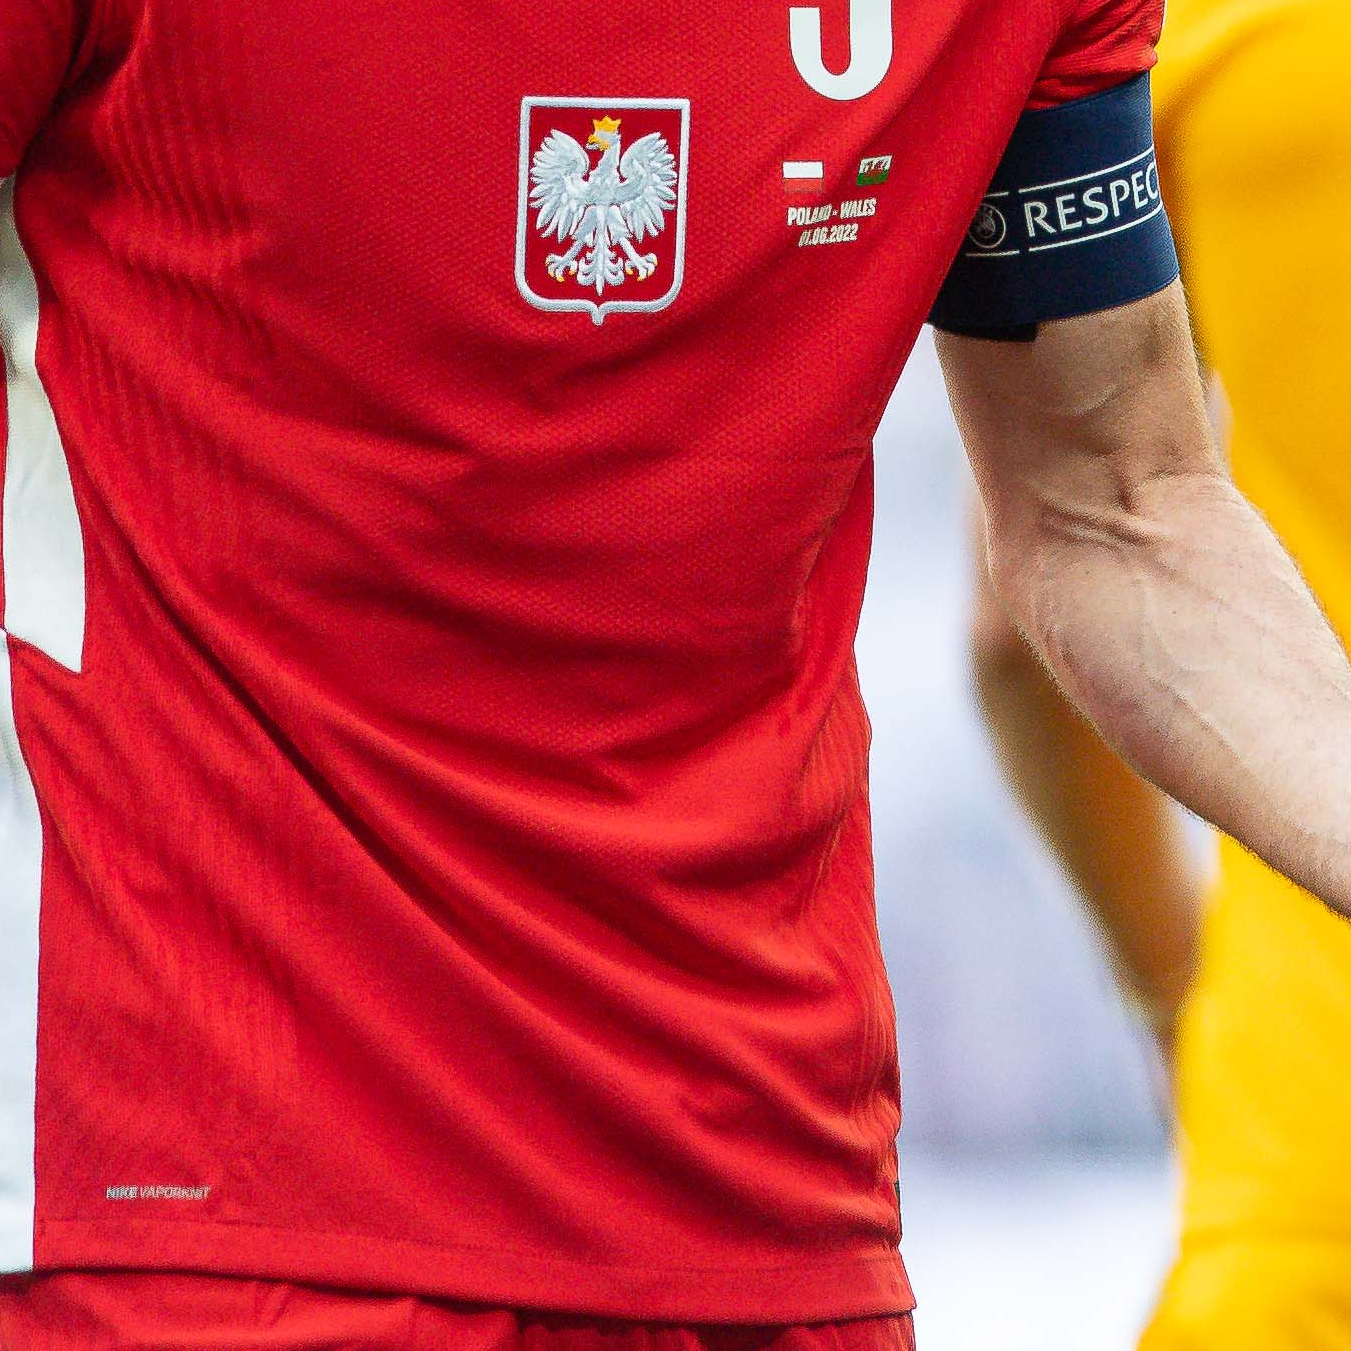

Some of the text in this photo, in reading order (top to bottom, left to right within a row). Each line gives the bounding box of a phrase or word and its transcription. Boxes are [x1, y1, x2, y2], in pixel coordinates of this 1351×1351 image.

[840, 198, 877, 219] WALES
[798, 223, 858, 247] 01.06.2022
[106, 1185, 138, 1199] NIKE
